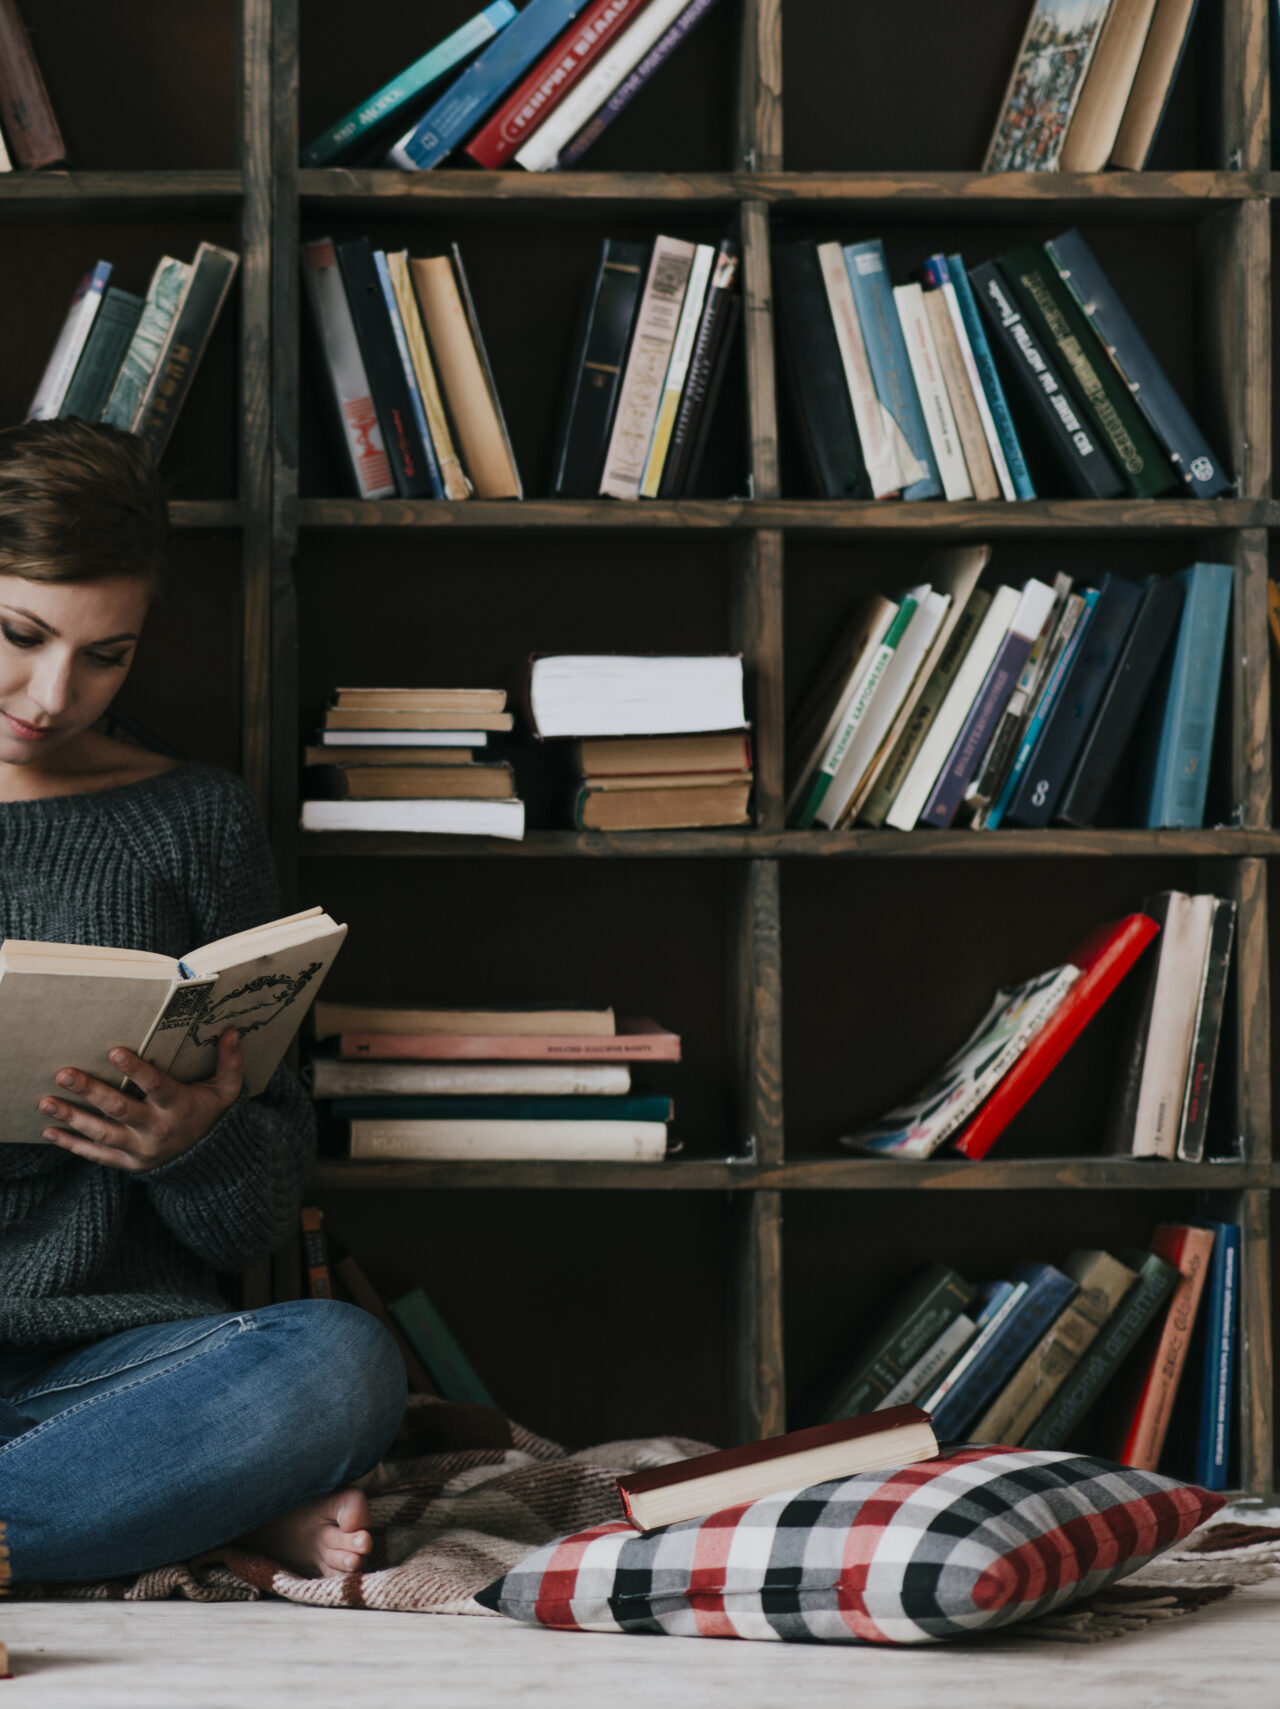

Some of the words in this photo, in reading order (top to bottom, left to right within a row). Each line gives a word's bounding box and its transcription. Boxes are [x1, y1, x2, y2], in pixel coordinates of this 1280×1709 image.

[512, 53, 578, 129] ГЕНРИХ
[825, 722, 855, 770] ЛЕЧЕНИЕ
[849, 649, 891, 722] КАРТОФЕЛЕМ
[1031, 779, 1049, 808] 8
